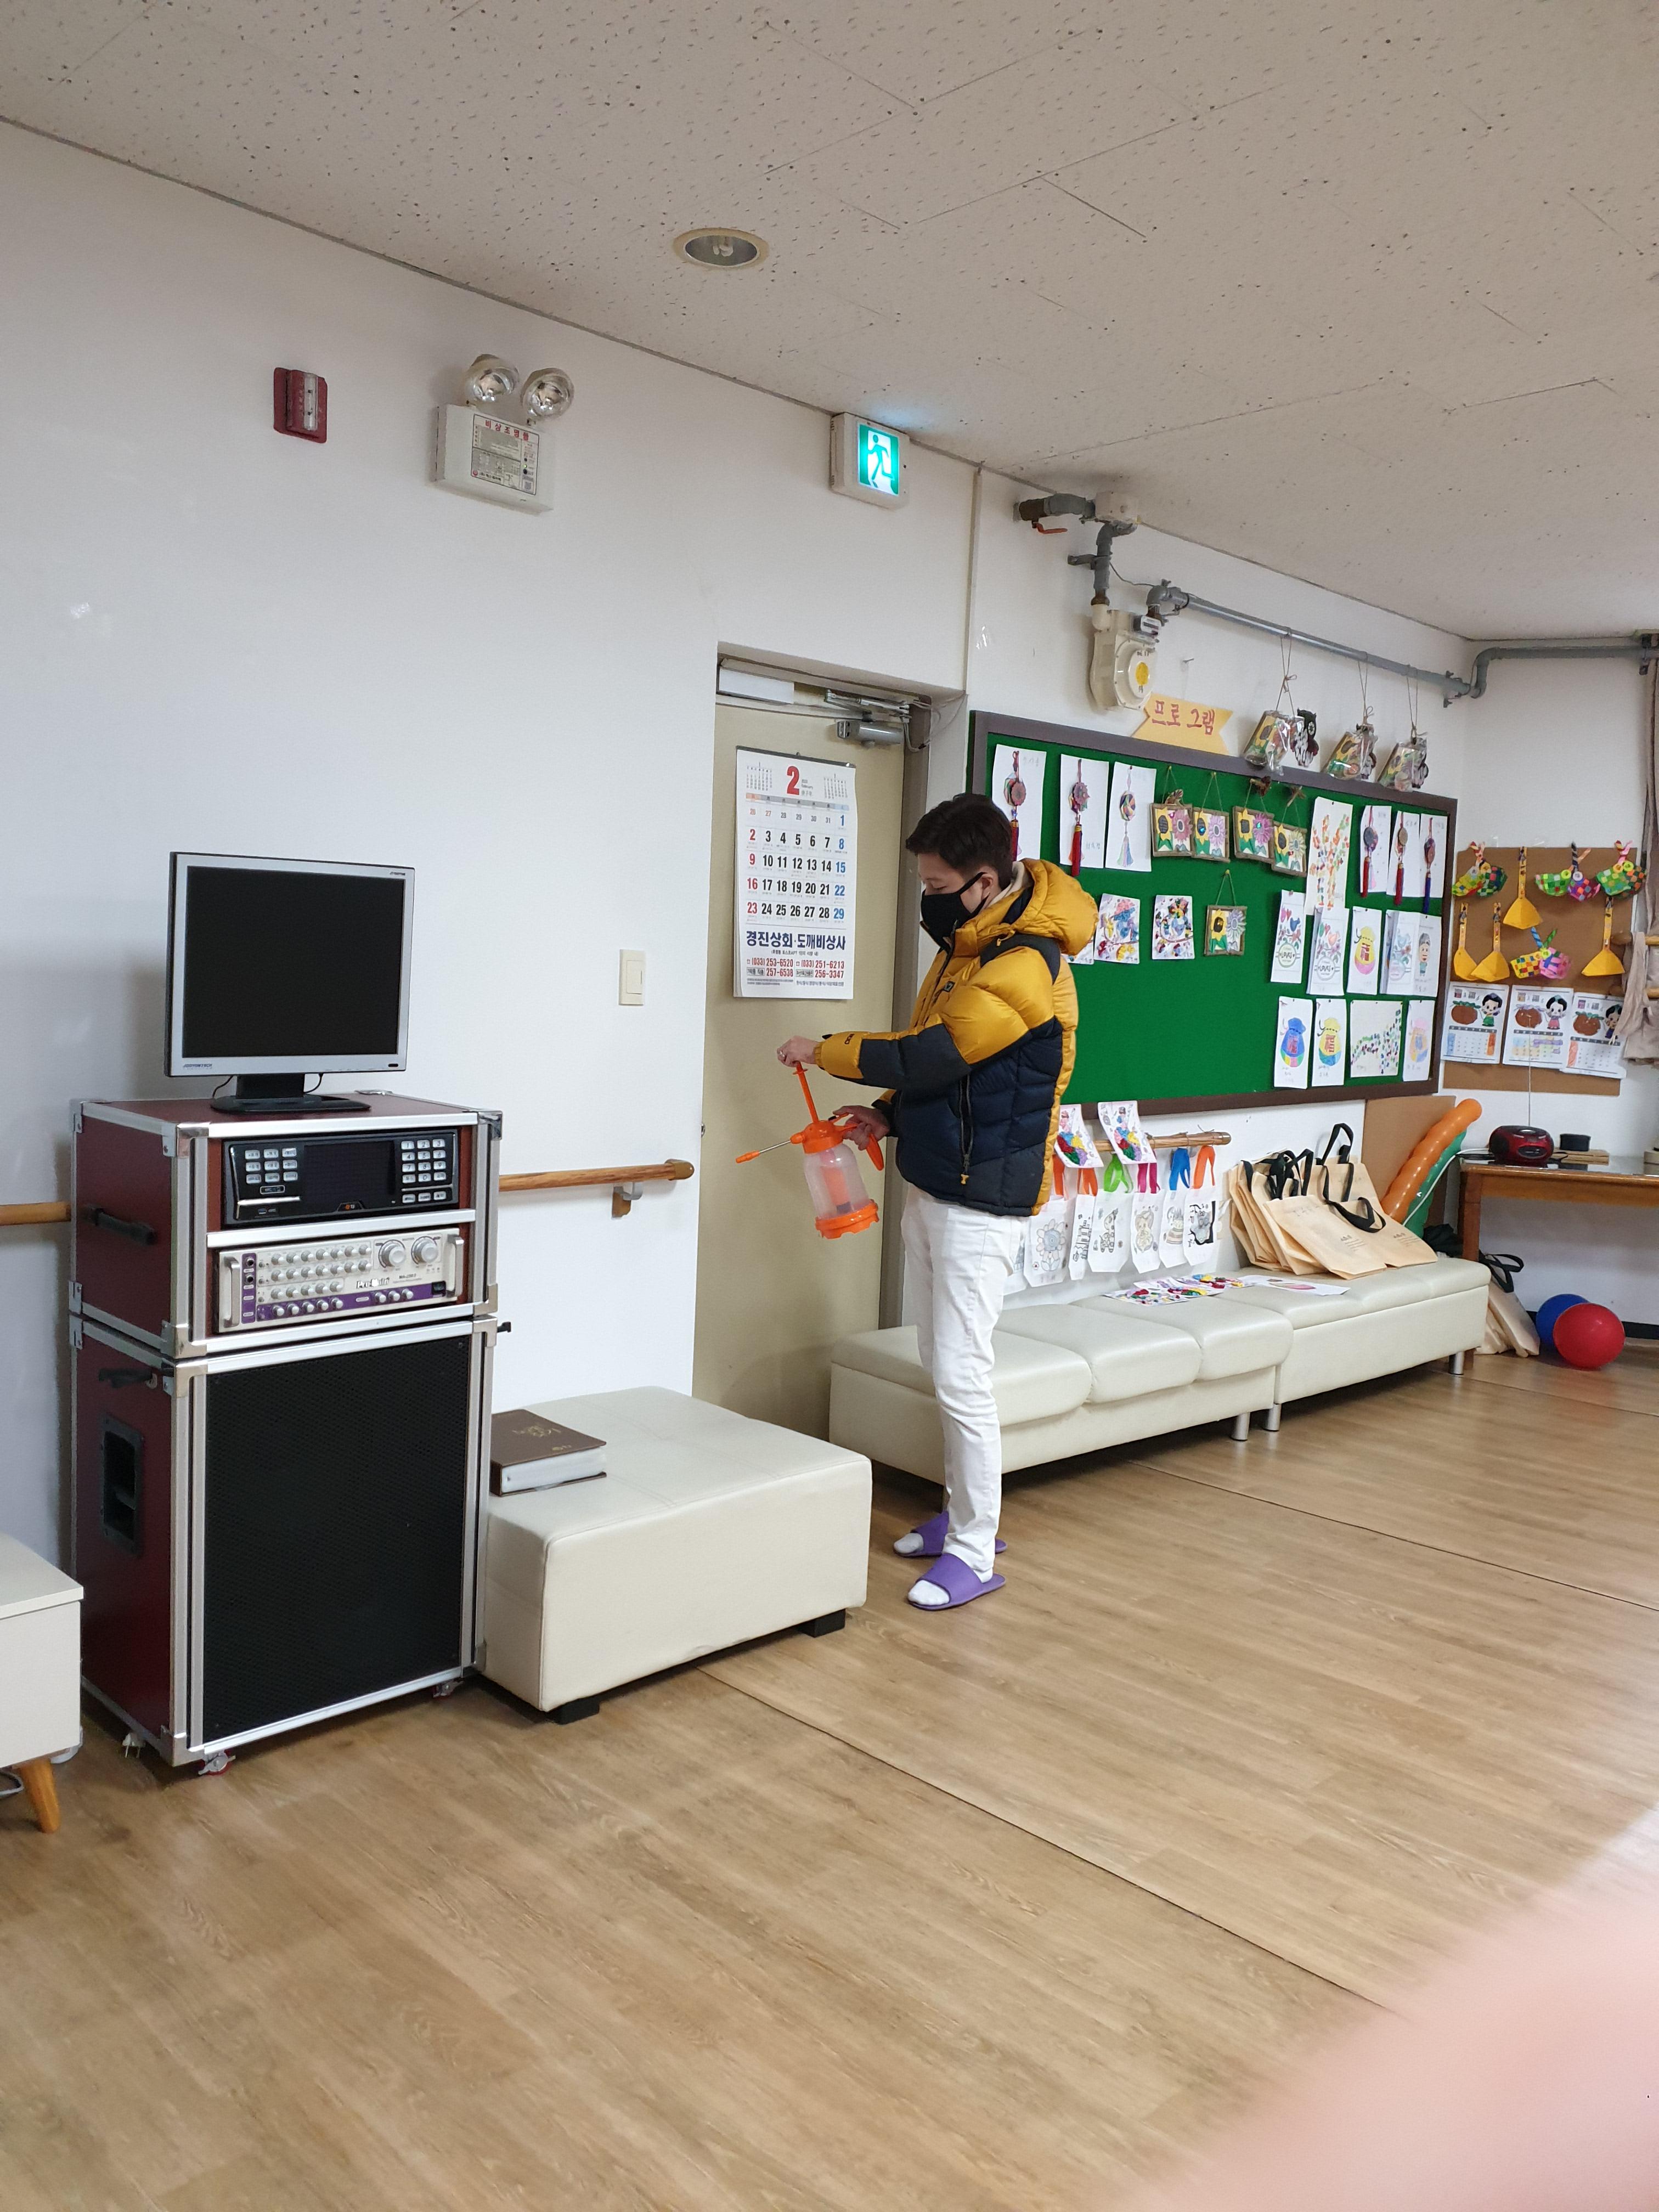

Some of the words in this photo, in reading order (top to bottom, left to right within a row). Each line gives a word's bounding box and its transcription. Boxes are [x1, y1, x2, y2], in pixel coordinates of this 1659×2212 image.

[787, 766, 799, 795] 2
[840, 815, 844, 826] 1
[750, 829, 755, 840] 2
[766, 831, 771, 842] 3
[780, 833, 786, 844] 4
[795, 834, 800, 845] 5
[810, 836, 815, 847] 6
[825, 837, 830, 848] 7
[839, 838, 844, 849] 8
[750, 854, 755, 865] 9
[763, 855, 773, 866] 10
[777, 856, 787, 868] 11
[793, 857, 802, 869] 12
[807, 859, 816, 870] 13
[822, 860, 831, 872] 14
[836, 862, 845, 873] 15
[747, 878, 758, 889] 16
[763, 879, 772, 890] 17
[777, 881, 787, 891] 18
[792, 882, 802, 893] 19
[805, 883, 816, 894] 20
[820, 884, 829, 895] 21
[834, 885, 845, 896] 22
[748, 902, 757, 913] 23
[762, 904, 772, 915] 24
[776, 904, 786, 916] 25
[791, 905, 800, 916] 26
[805, 906, 815, 917] 27
[819, 907, 829, 918] 28
[834, 908, 844, 919] 29
[747, 931, 792, 947] 경진상회
[766, 958, 793, 967] 253-6520
[815, 960, 844, 969] 251-6213
[766, 968, 793, 977] 257-6538
[815, 970, 844, 978] 256-3347
